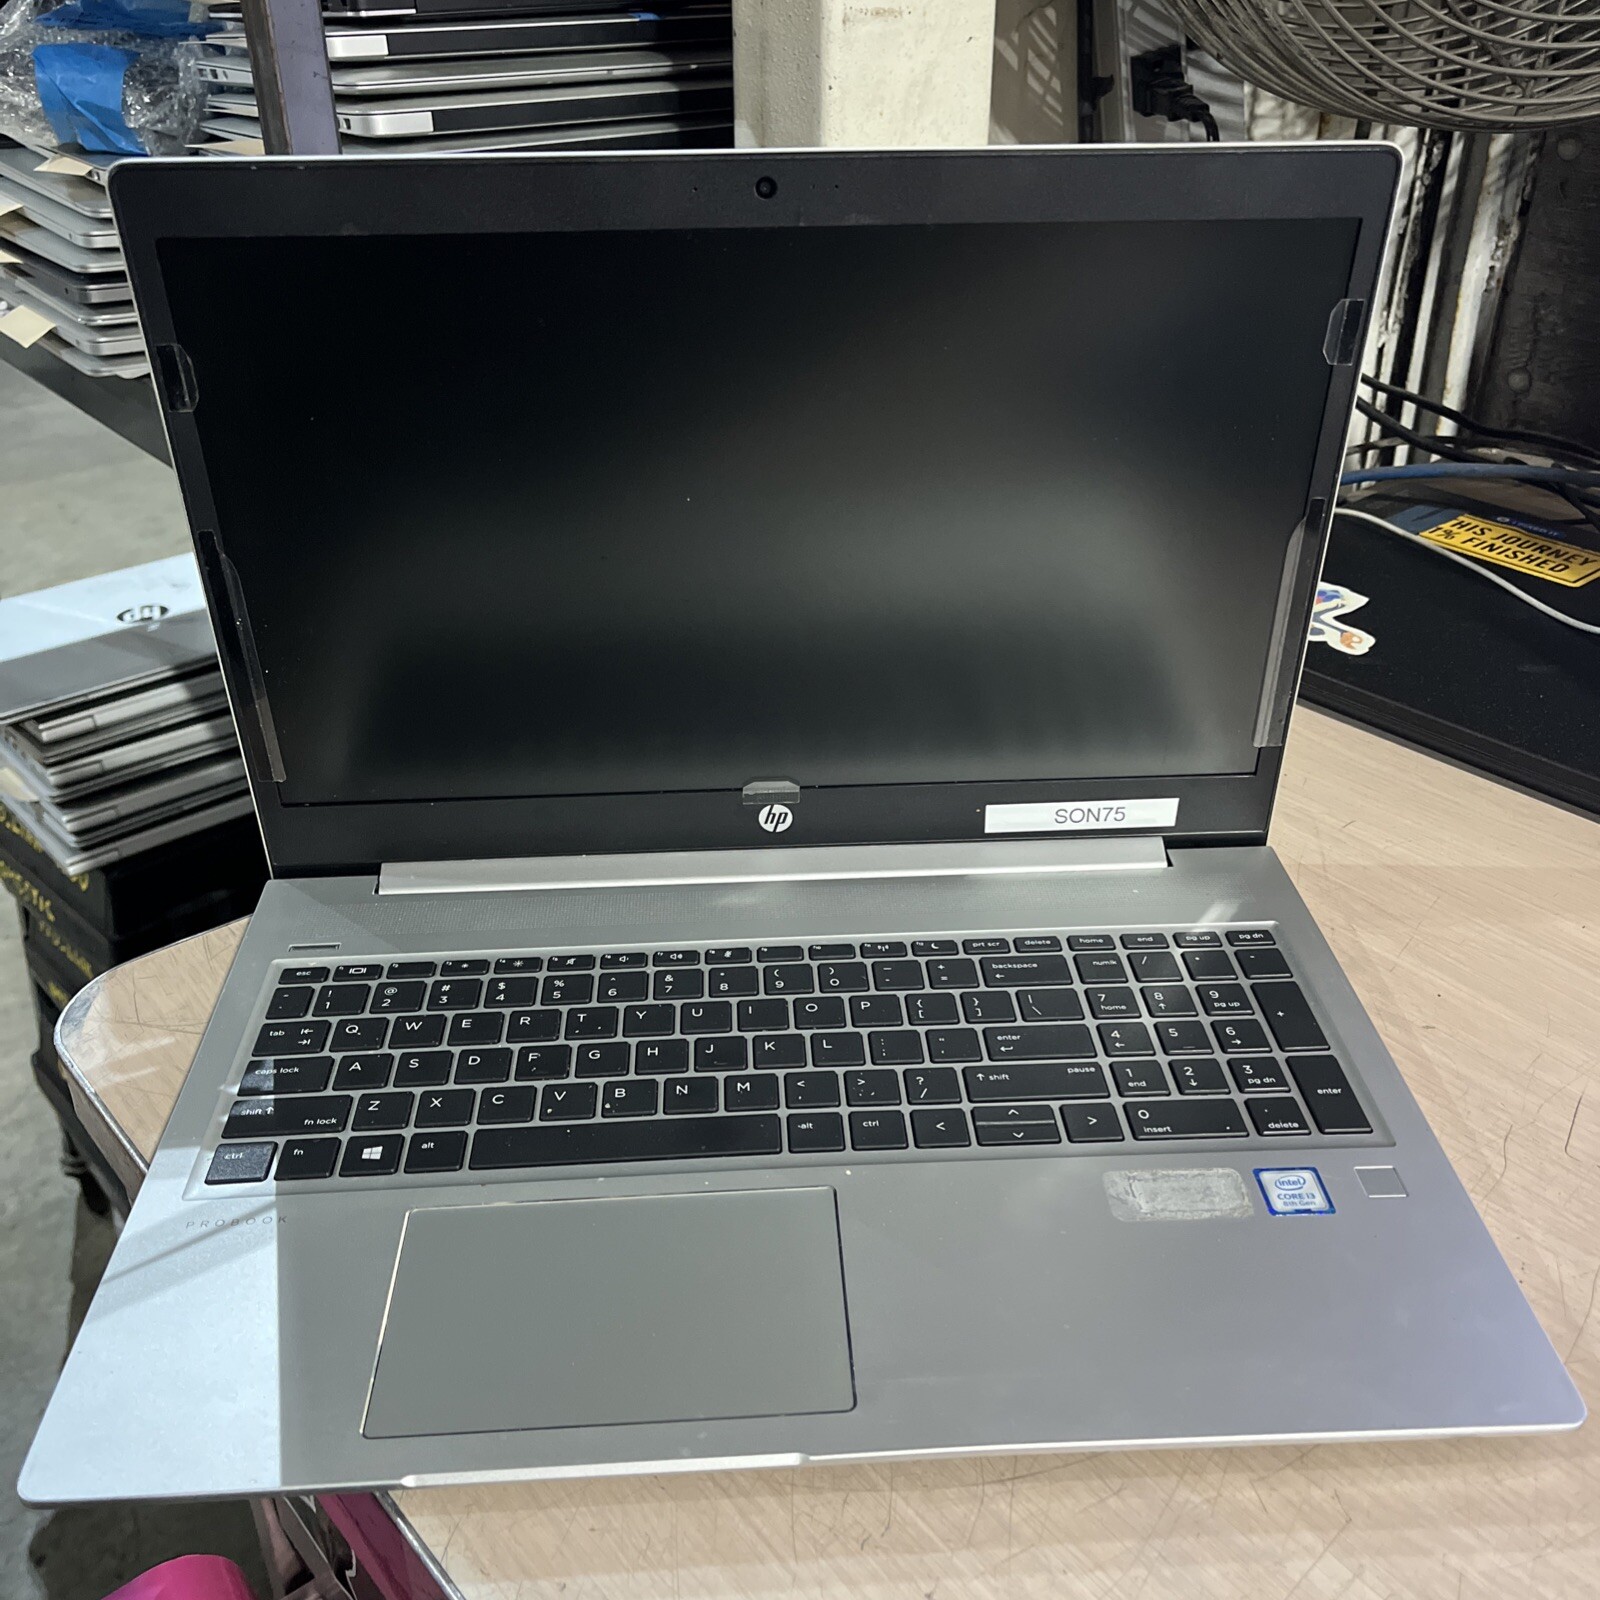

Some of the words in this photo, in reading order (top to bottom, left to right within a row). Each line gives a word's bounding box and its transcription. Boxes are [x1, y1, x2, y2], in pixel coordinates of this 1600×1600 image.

[1490, 533, 1598, 566] JOURNEY
[1461, 538, 1570, 573] FINISHED
[761, 803, 791, 832] hp
[1054, 806, 1126, 825] SON75
[498, 982, 505, 990] $
[384, 987, 397, 995] @
[1154, 992, 1163, 1000] 8
[578, 1014, 586, 1022] T
[636, 1011, 646, 1019] Y
[406, 1022, 422, 1030] W
[462, 1019, 472, 1027] E
[346, 1025, 360, 1035] Q
[1226, 1027, 1235, 1035] 6
[765, 1042, 775, 1050] K
[823, 1040, 832, 1048] L
[648, 1047, 658, 1056] H
[706, 1045, 713, 1053] J
[529, 1053, 540, 1062] F
[589, 1050, 600, 1059] G
[409, 1059, 419, 1068] S
[469, 1056, 480, 1065] D
[349, 1062, 361, 1071] A
[1243, 1065, 1253, 1074] 3
[255, 1068, 277, 1076] caps
[1126, 1069, 1132, 1077] 1
[1184, 1067, 1194, 1075] 2
[916, 1077, 923, 1085] ?
[677, 1085, 687, 1095] N
[737, 1082, 750, 1091] M
[555, 1092, 566, 1100] V
[615, 1089, 625, 1097] B
[430, 1098, 442, 1107] X
[492, 1095, 504, 1104] C
[368, 1101, 380, 1110] Z
[241, 1107, 262, 1115] shift
[1277, 1178, 1302, 1187] intel
[1277, 1192, 1305, 1200] CORE
[185, 1215, 288, 1229] PROBOOK
